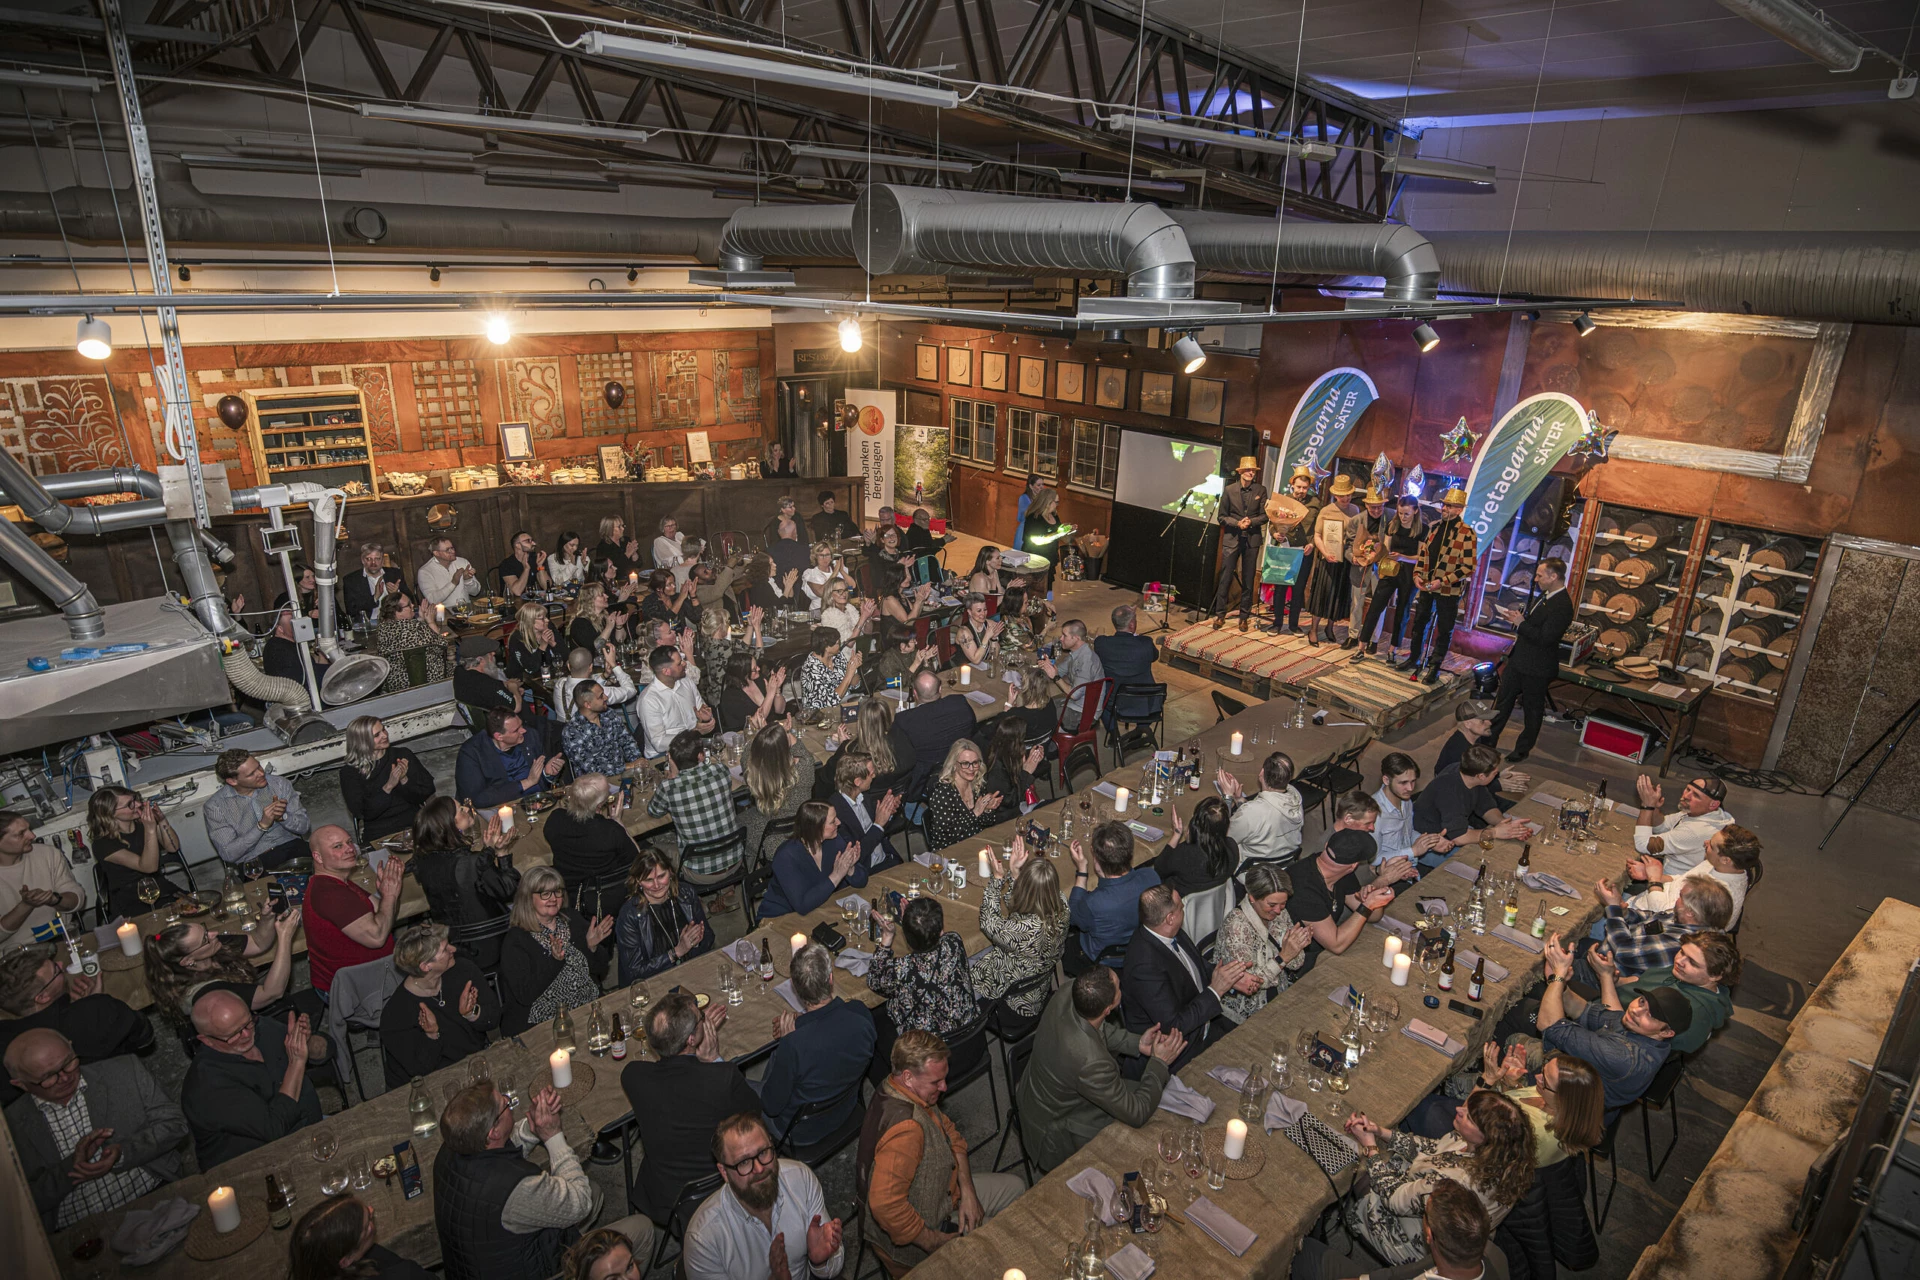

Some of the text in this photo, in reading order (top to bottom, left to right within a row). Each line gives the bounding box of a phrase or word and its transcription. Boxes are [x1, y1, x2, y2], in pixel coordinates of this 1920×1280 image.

[1297, 387, 1341, 465] tagarna
[1334, 391, 1359, 430] SÄTER
[872, 441, 883, 499] Bergslagen
[1533, 421, 1566, 466] SÄTER
[1471, 414, 1544, 543] öretagarna
